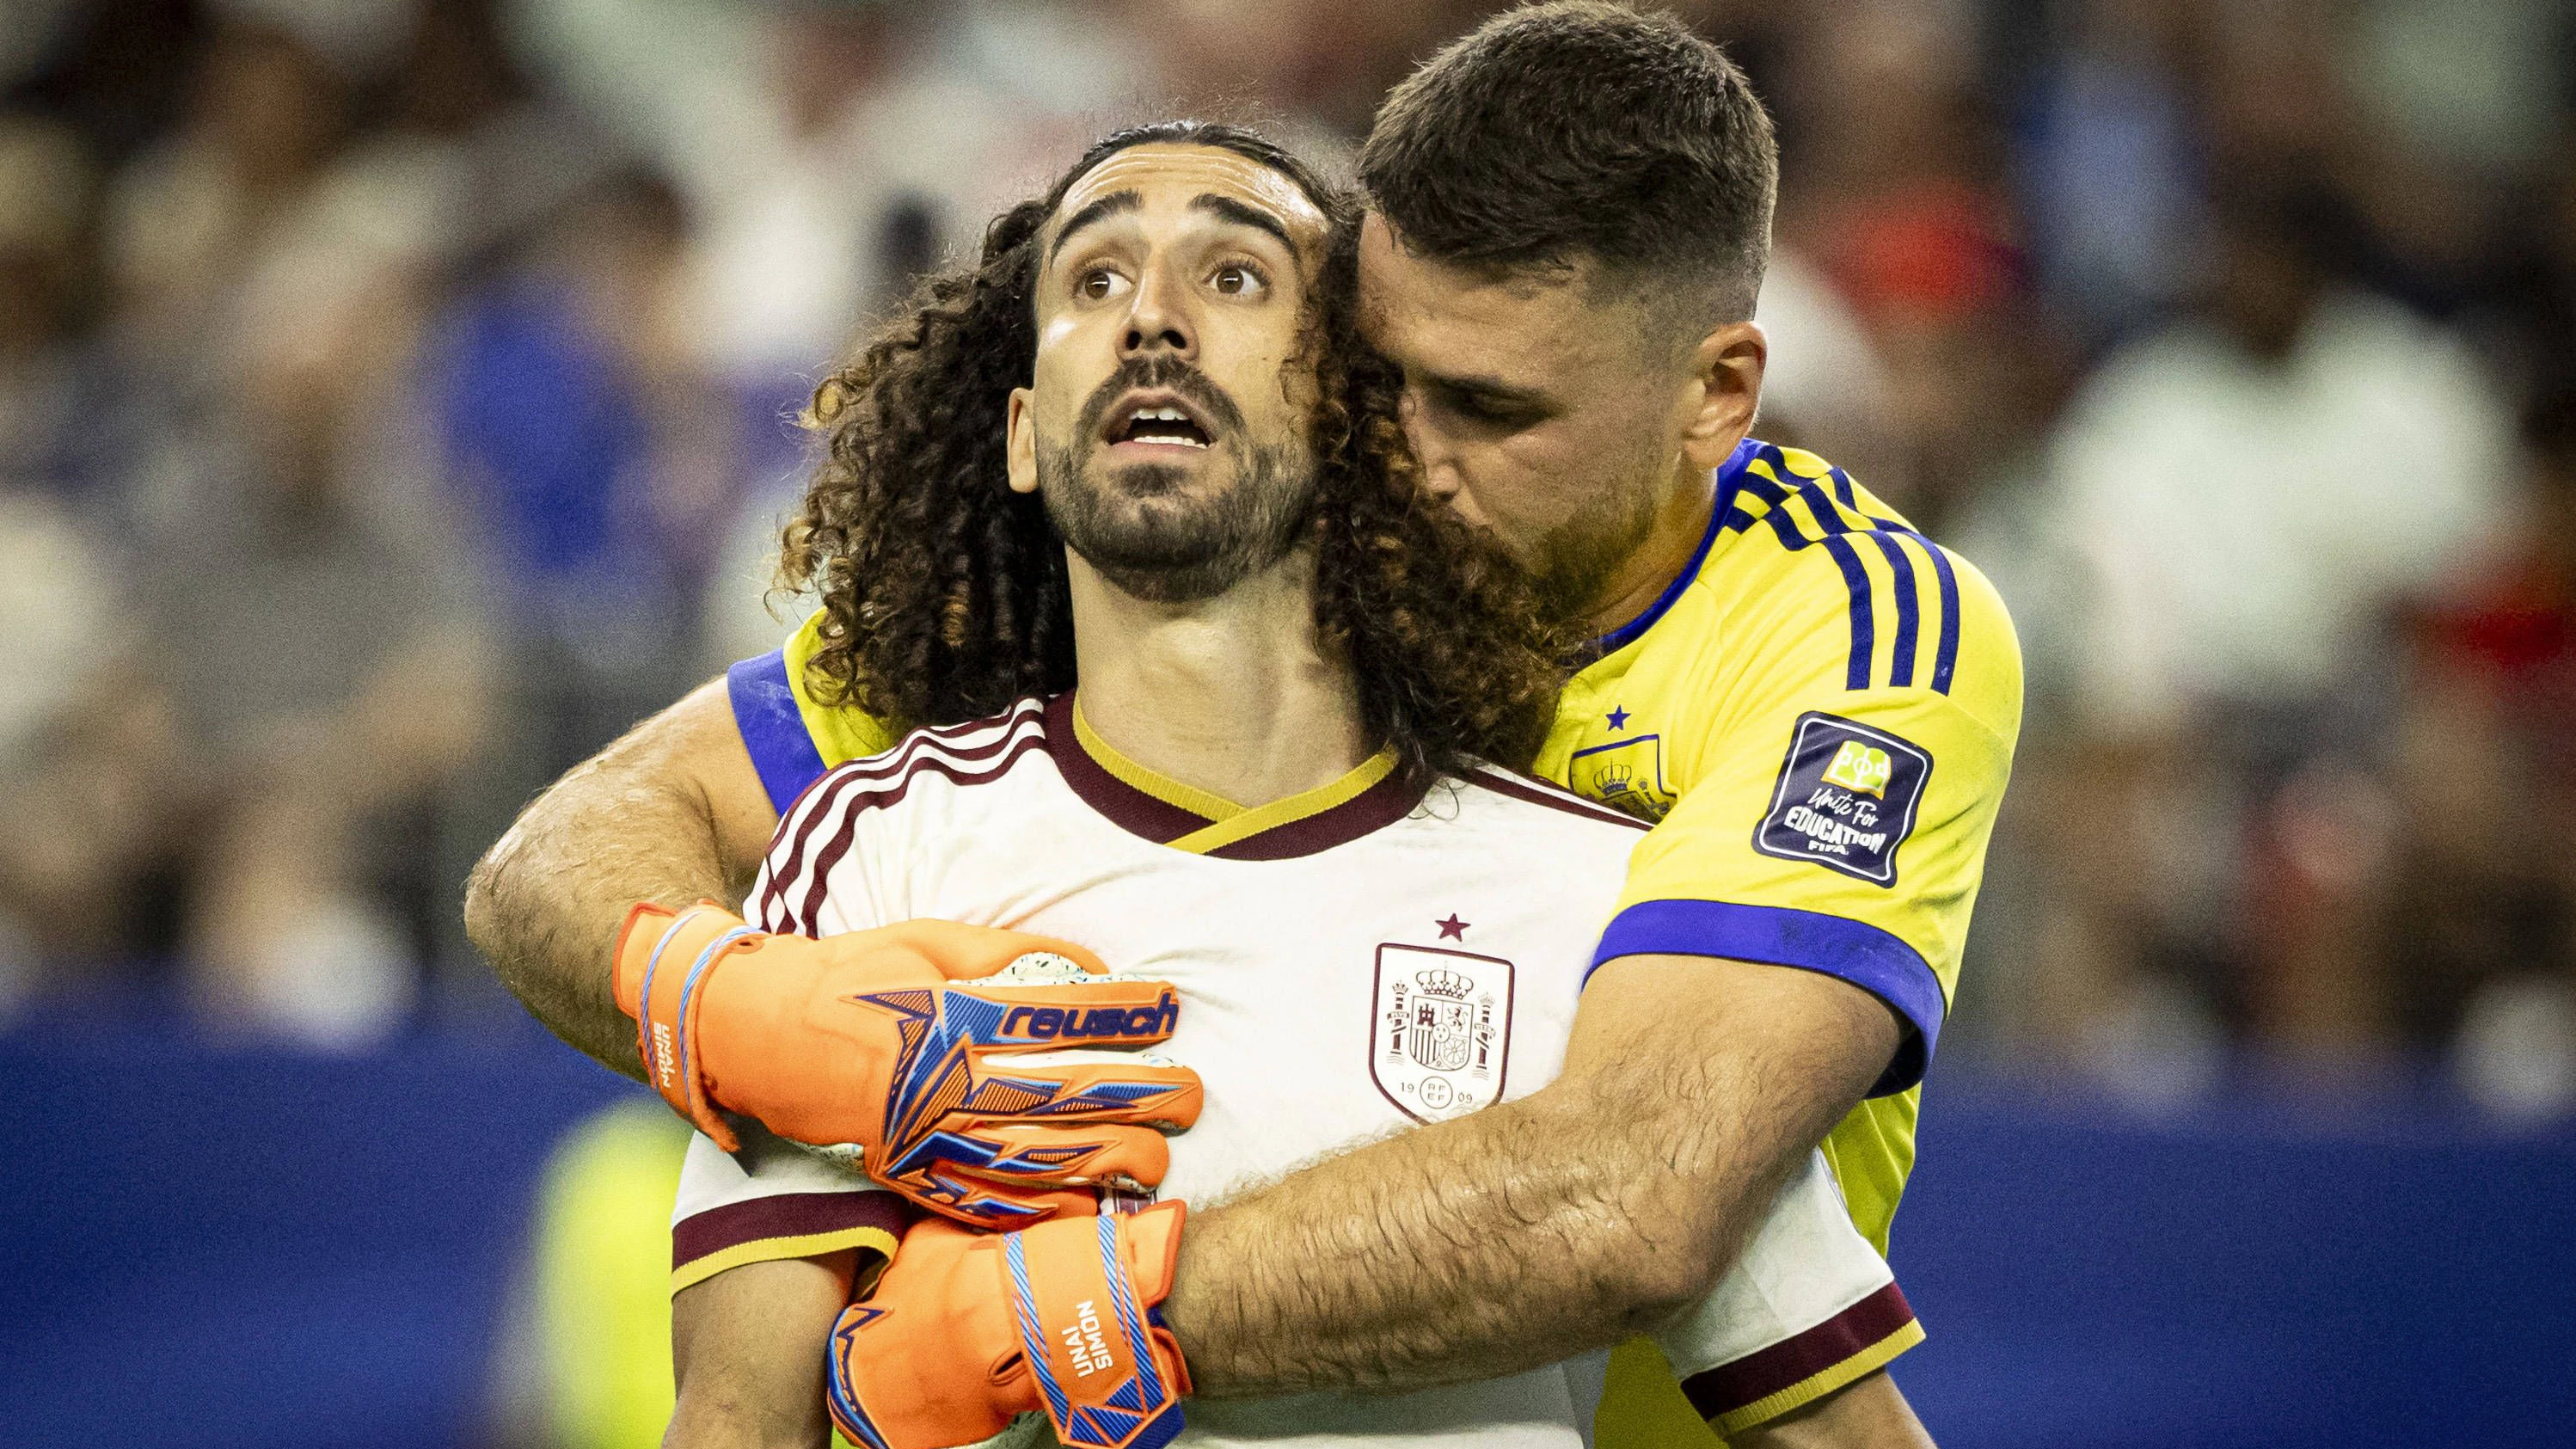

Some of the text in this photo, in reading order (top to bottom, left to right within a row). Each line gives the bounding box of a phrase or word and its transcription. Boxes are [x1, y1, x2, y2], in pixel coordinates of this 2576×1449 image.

[1807, 788, 1879, 827] Unite For
[1783, 806, 1887, 855] EDUCATION
[1808, 840, 1848, 855] FIFA
[1003, 992, 1179, 1040] reusch
[662, 1024, 676, 1074] UNAI
[1401, 1082, 1414, 1093] 19
[1458, 1092, 1473, 1104] 09
[1061, 1326, 1095, 1378] UNAI
